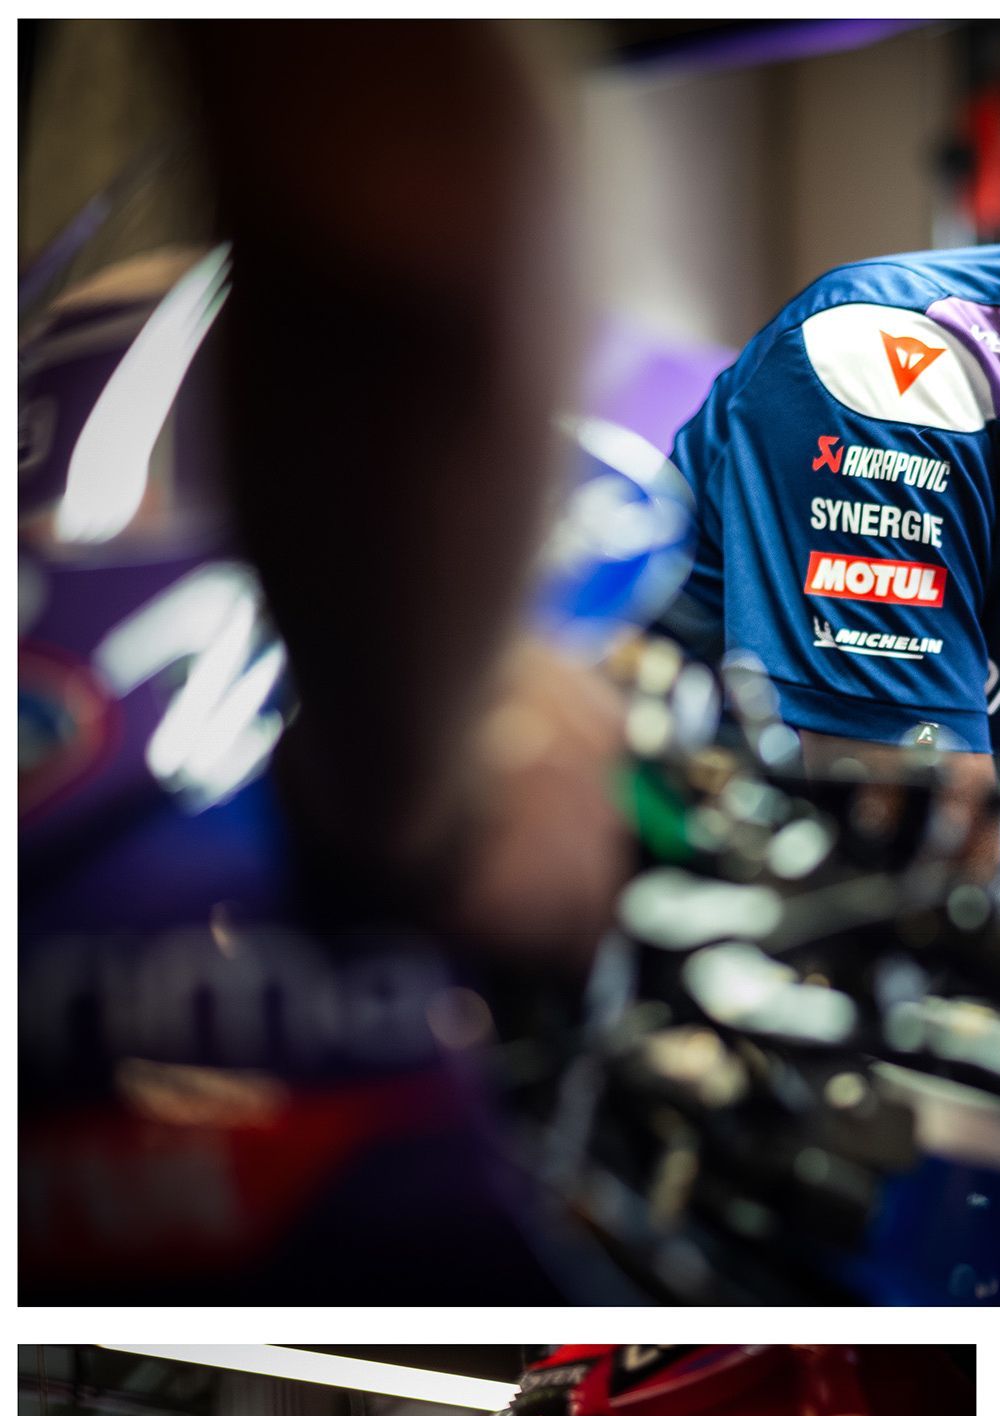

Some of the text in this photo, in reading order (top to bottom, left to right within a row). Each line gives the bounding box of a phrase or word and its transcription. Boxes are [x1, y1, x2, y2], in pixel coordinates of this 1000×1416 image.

[810, 497, 944, 548] SYNERGIE
[811, 558, 939, 601] MOTUL
[835, 628, 943, 653] MICHELIN
